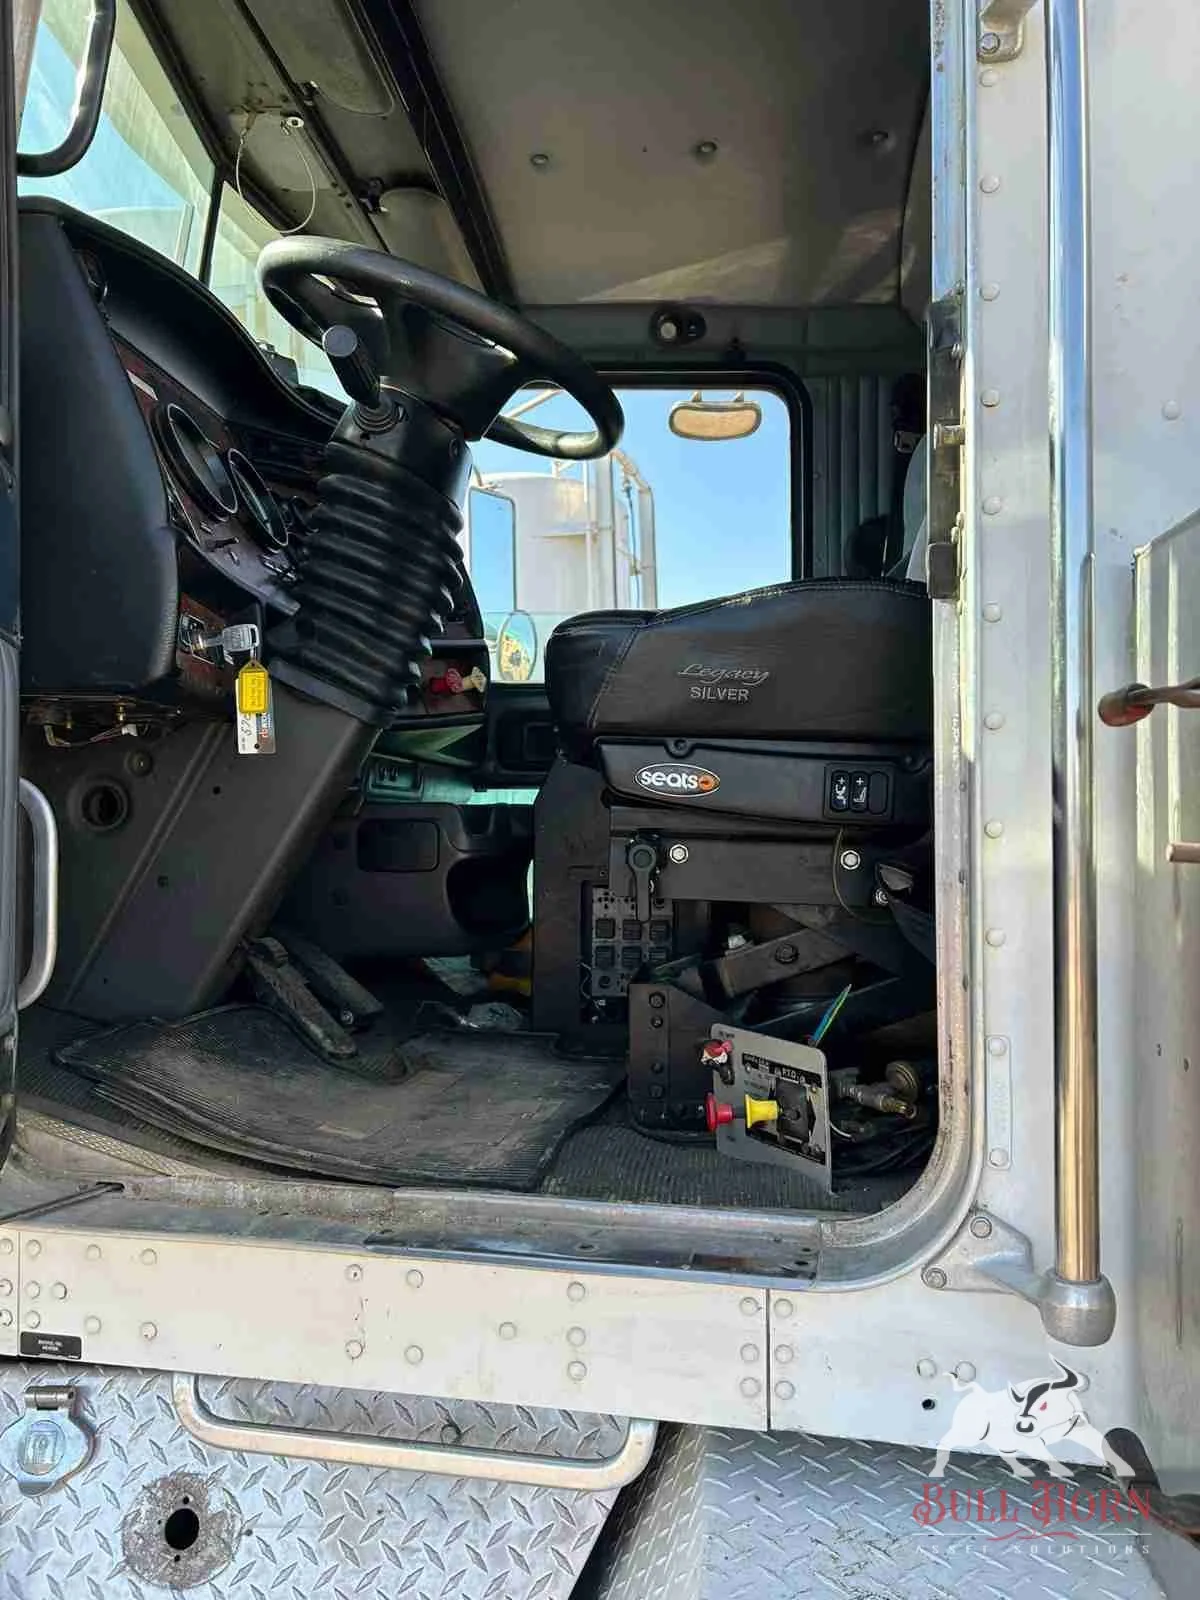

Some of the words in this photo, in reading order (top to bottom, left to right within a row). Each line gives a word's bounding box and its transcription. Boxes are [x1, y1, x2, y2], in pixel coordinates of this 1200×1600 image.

[677, 663, 770, 686] Legacy
[690, 686, 750, 701] SILVER
[640, 771, 698, 789] seats
